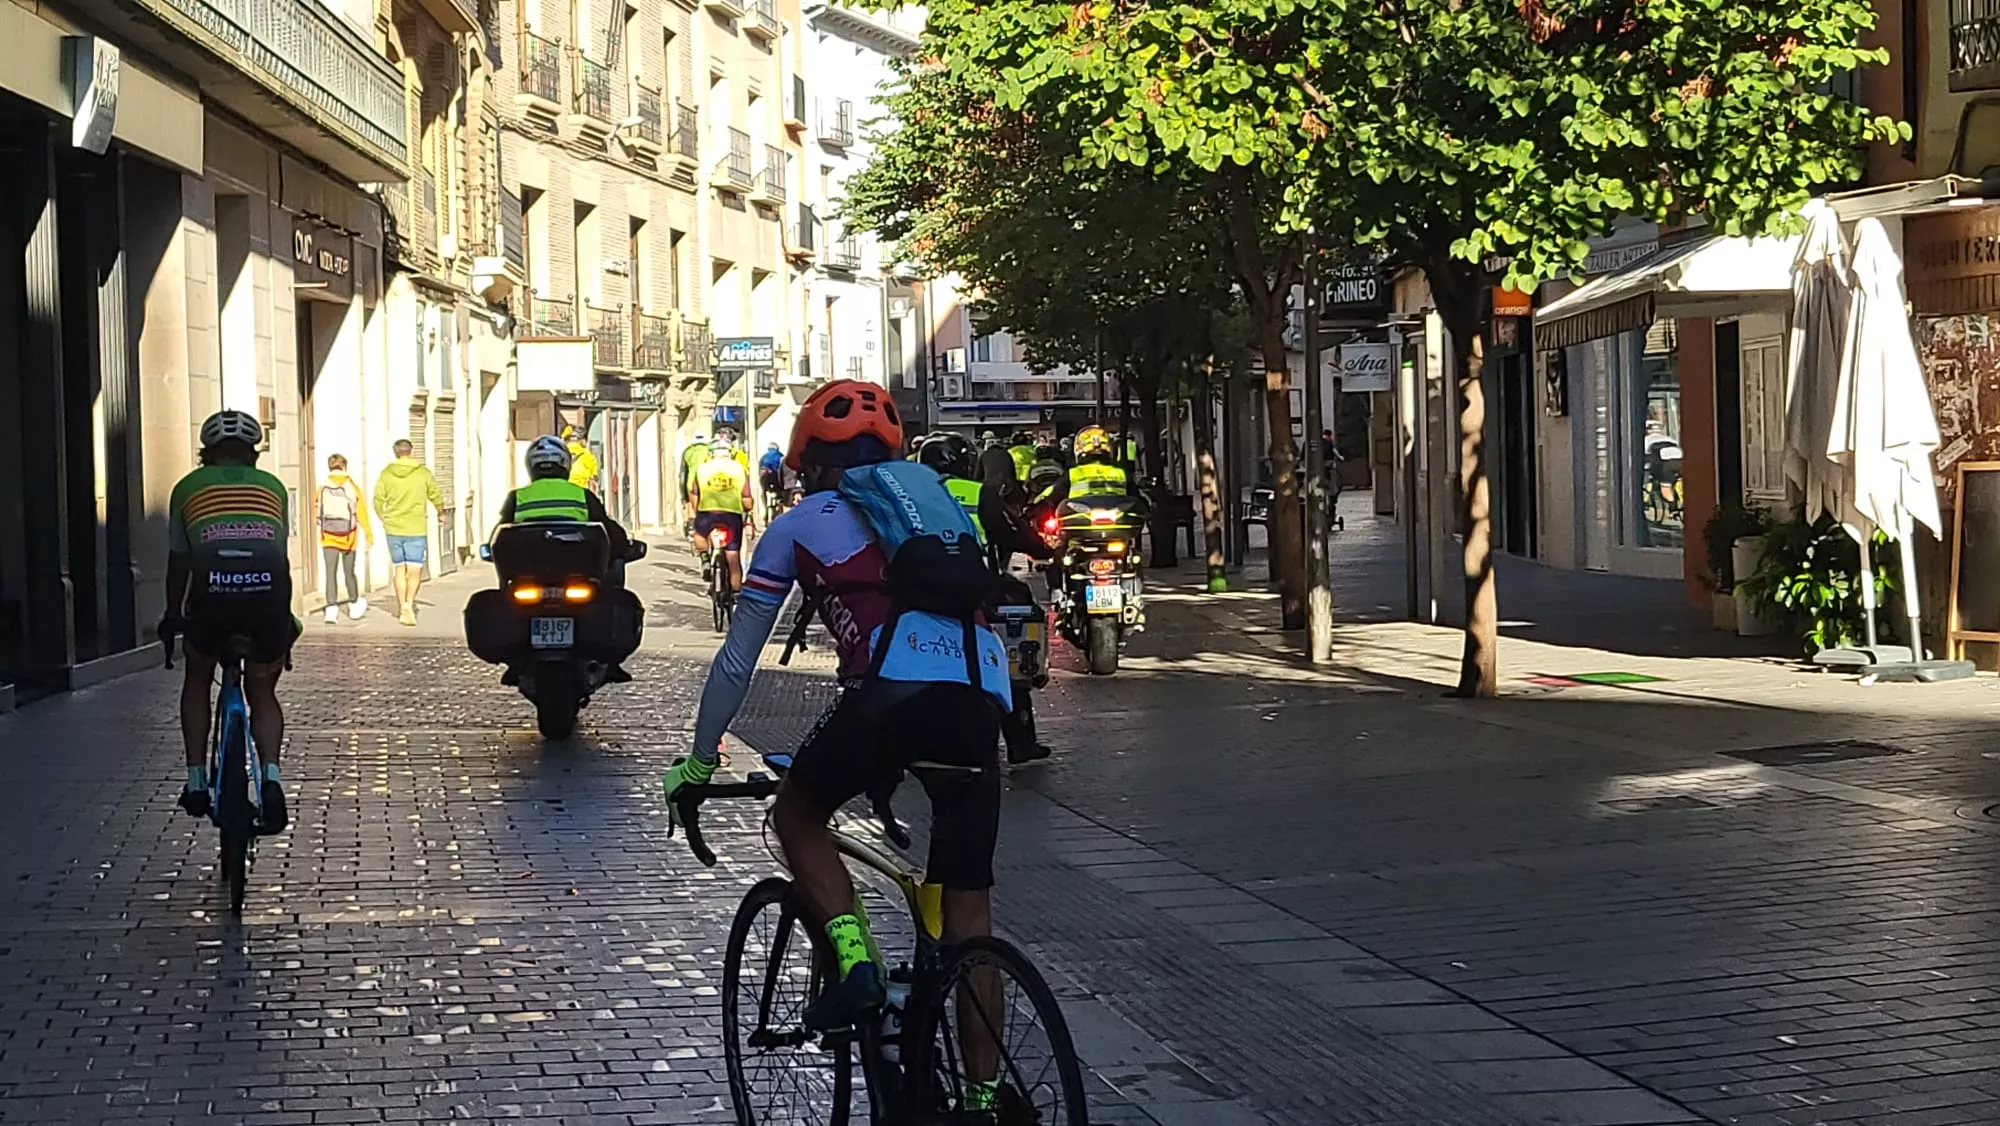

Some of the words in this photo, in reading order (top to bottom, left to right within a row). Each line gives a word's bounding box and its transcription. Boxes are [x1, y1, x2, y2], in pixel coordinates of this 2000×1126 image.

[1494, 306, 1529, 316] orange
[719, 344, 772, 360] Arenas
[1344, 353, 1388, 371] Ana
[209, 571, 272, 584] Huesca
